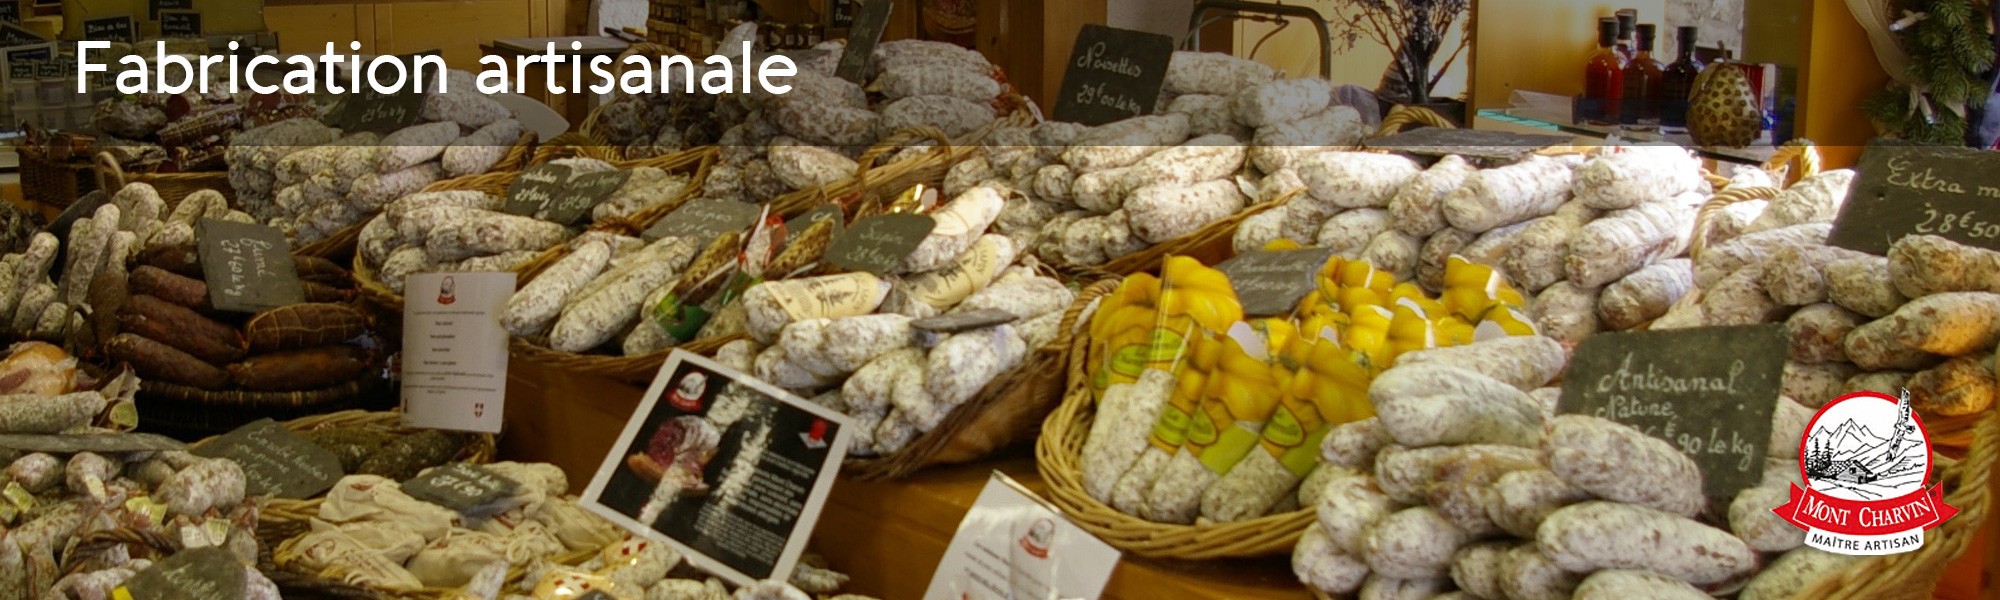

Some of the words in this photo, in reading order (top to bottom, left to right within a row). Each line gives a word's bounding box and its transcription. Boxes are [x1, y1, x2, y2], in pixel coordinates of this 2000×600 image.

[1077, 41, 1142, 78] Noisettes
[1887, 156, 1966, 194] Extra
[1977, 185, 2000, 199] m
[1915, 202, 2000, 238] 28€50
[1708, 428, 1728, 455] le
[1732, 431, 1754, 472] kg
